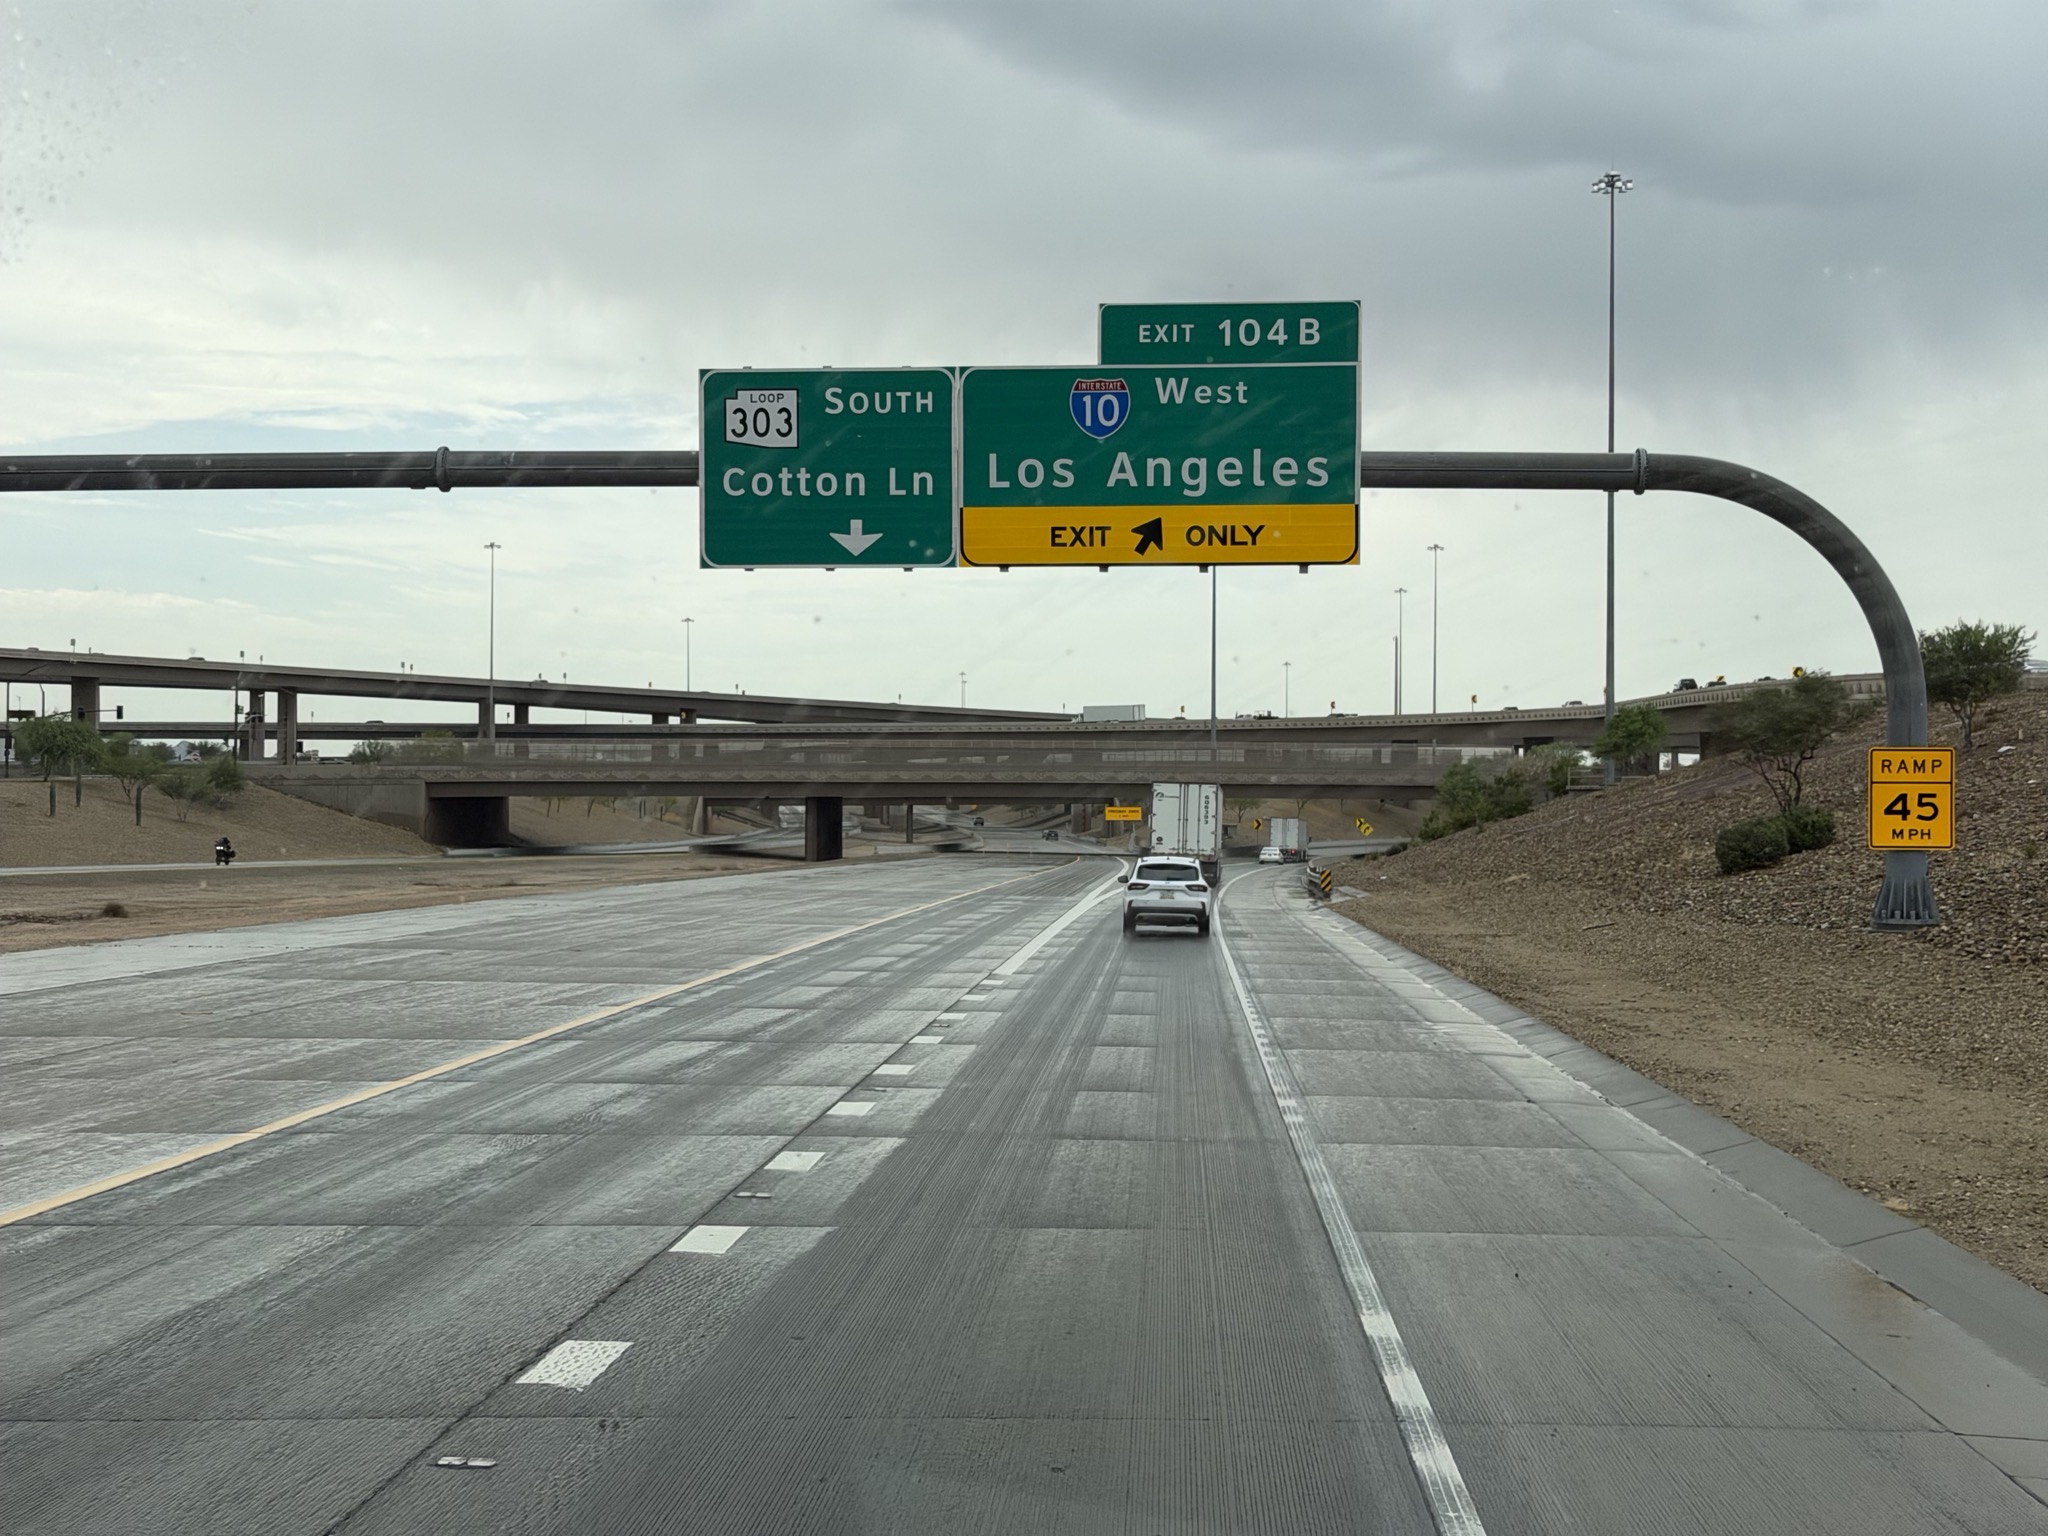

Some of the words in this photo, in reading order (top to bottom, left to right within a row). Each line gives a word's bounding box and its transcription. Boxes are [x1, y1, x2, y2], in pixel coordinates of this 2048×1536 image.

[1138, 324, 1195, 343] EXIT
[750, 393, 785, 404] LOOP
[1078, 381, 1122, 391] INTERSTATE
[1155, 377, 1248, 404] West
[824, 387, 933, 414] SOUTH
[1082, 394, 1120, 427] 10
[730, 407, 793, 438] 303
[723, 467, 866, 497] Cotton
[888, 467, 934, 496] Ln
[988, 453, 1075, 488] Los
[1106, 448, 1329, 497] Angeles
[1050, 526, 1112, 547] EXIT
[1185, 524, 1266, 547] ONLY
[1881, 759, 1943, 774] RAMP
[1883, 792, 1939, 822] 45
[1891, 828, 1932, 840] MPH
